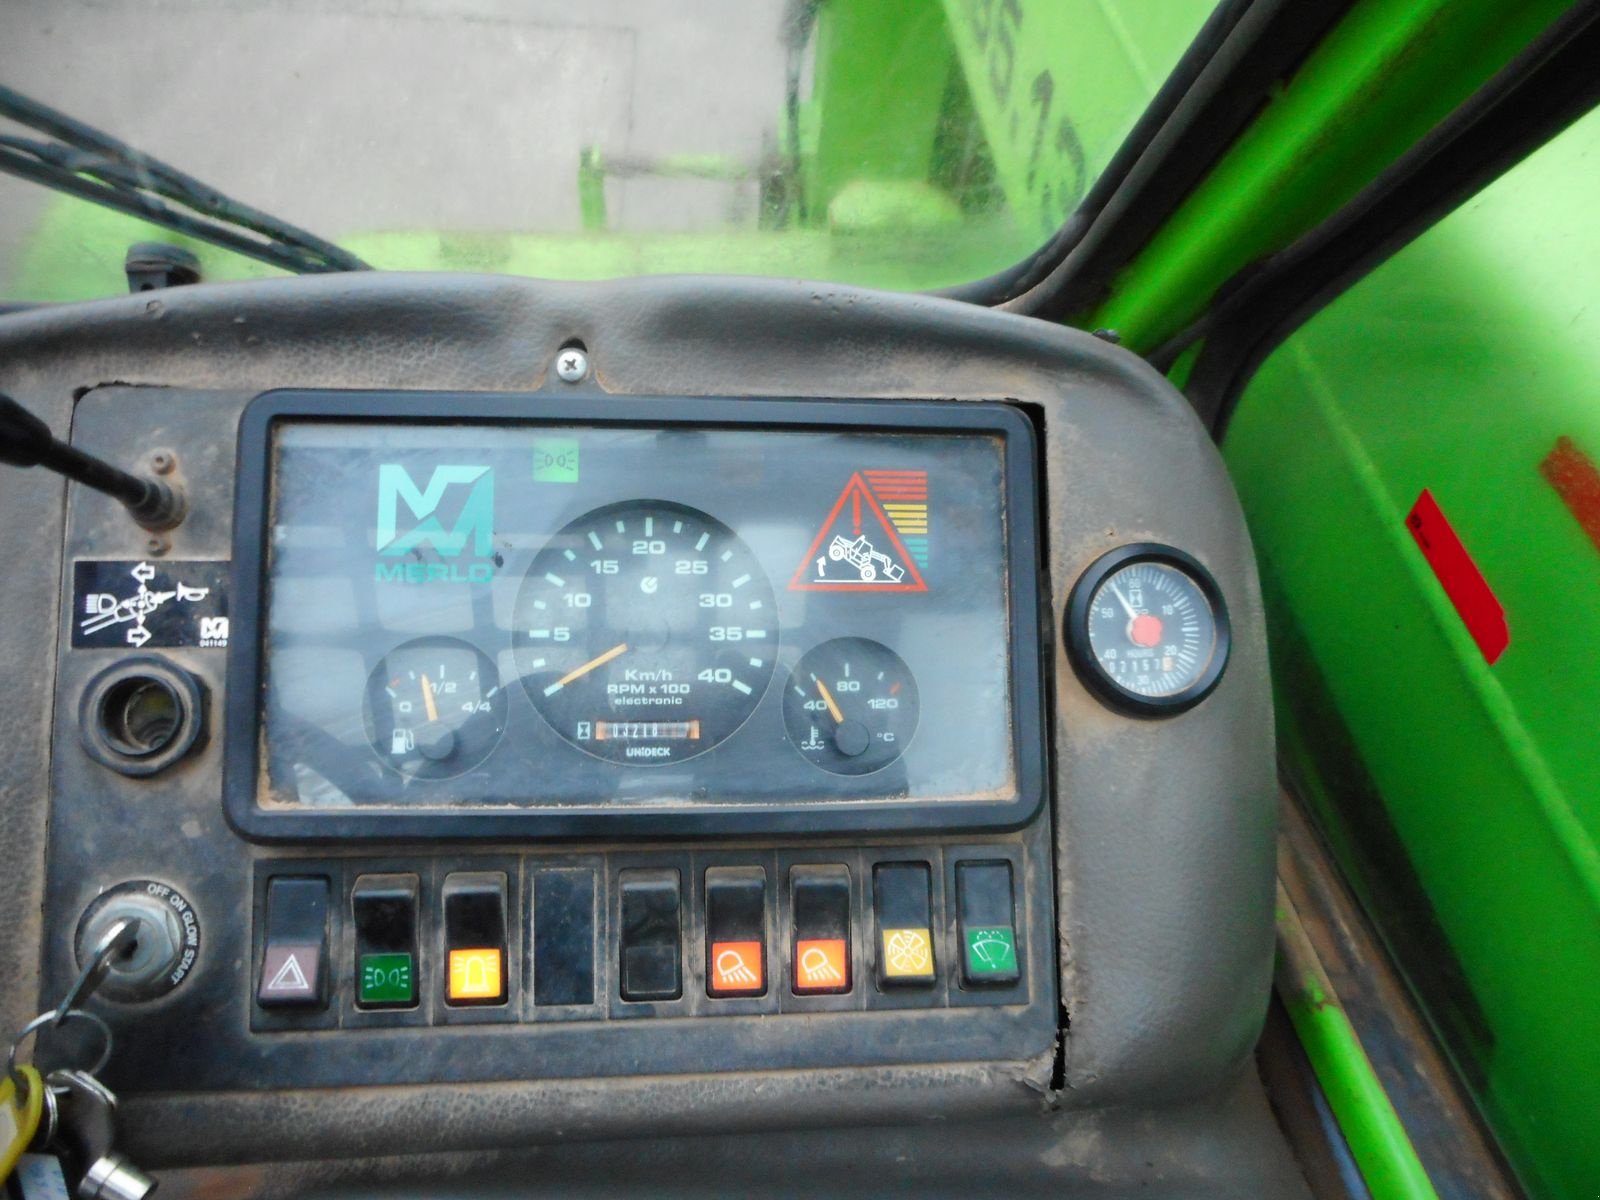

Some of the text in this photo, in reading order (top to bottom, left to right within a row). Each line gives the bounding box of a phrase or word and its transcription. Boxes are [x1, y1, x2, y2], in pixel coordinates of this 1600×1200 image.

[632, 540, 666, 555] 20
[375, 563, 493, 583] MERLO
[590, 560, 619, 574] 15
[674, 560, 708, 575] 25
[563, 593, 592, 608] 10
[699, 593, 733, 608] 30
[1101, 607, 1114, 619] 50
[1162, 604, 1174, 615] 10
[553, 627, 570, 642] 5
[709, 626, 742, 642] 35
[1103, 649, 1117, 659] 40
[624, 669, 673, 682] Km/h
[697, 668, 733, 683] 40
[430, 682, 457, 695] 1/2
[607, 684, 645, 694] RPM
[661, 684, 691, 694] 100
[837, 681, 860, 692] 80
[399, 701, 412, 713] 0
[461, 700, 492, 714] 4/4
[614, 696, 683, 705] electronic
[803, 700, 827, 711] 40
[867, 698, 899, 709] 120
[147, 883, 198, 985] OFF ON GLOW START
